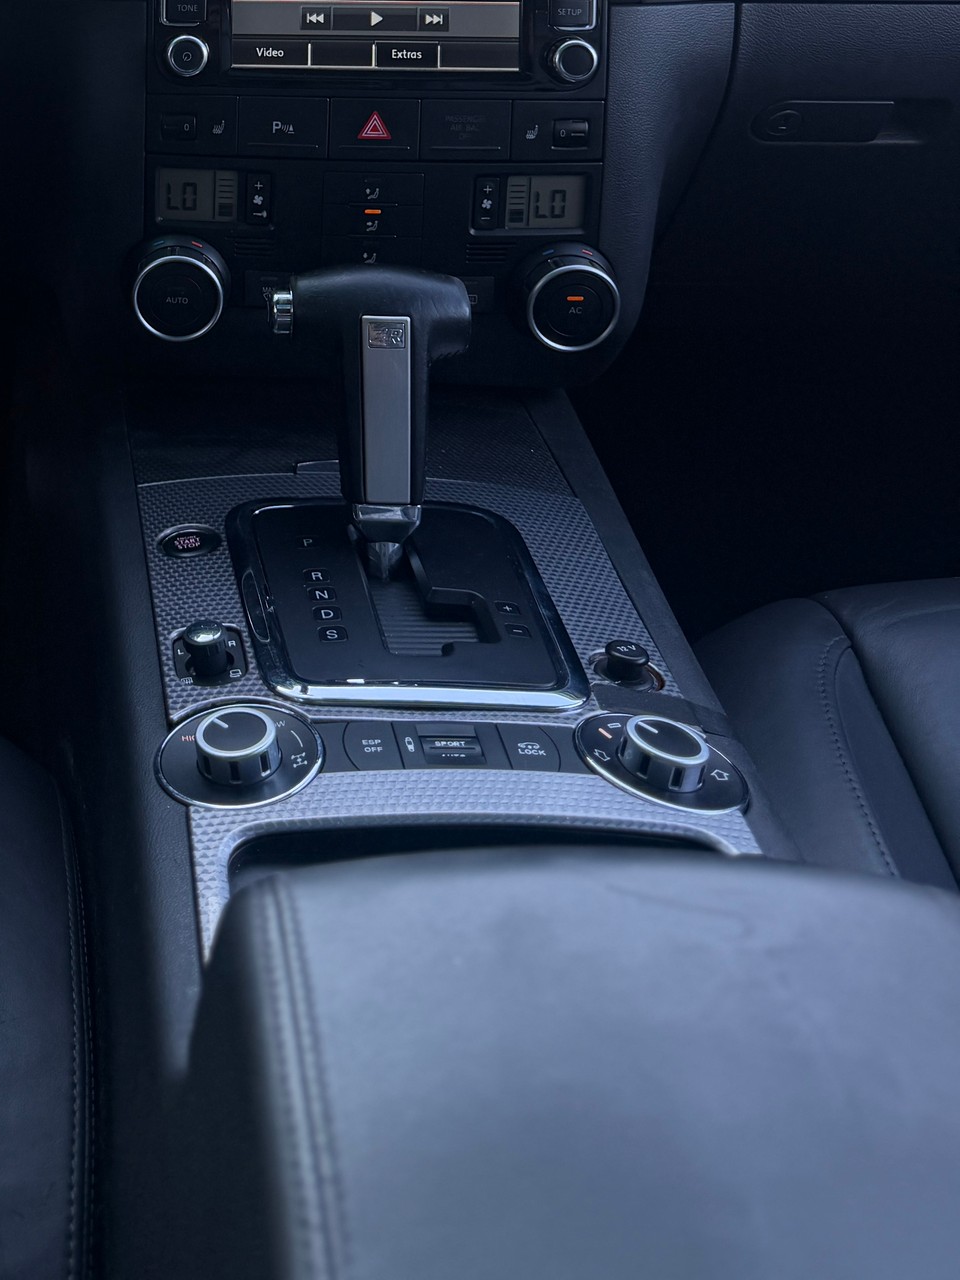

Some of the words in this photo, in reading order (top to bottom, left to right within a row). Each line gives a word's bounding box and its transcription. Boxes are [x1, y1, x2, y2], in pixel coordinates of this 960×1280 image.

[177, 3, 199, 13] TONE
[557, 7, 583, 17] SETUP
[255, 46, 285, 58] Video
[390, 48, 423, 60] Extras
[166, 182, 197, 210] LO
[534, 189, 566, 218] LO
[165, 295, 189, 305] AUTO
[568, 305, 583, 315] AC
[174, 537, 201, 545] START
[177, 542, 201, 550] STOP
[302, 538, 313, 547] P
[311, 571, 323, 581] R
[315, 590, 329, 599] N
[320, 609, 334, 619] D
[326, 629, 338, 639] S
[518, 748, 547, 756] LOCK
